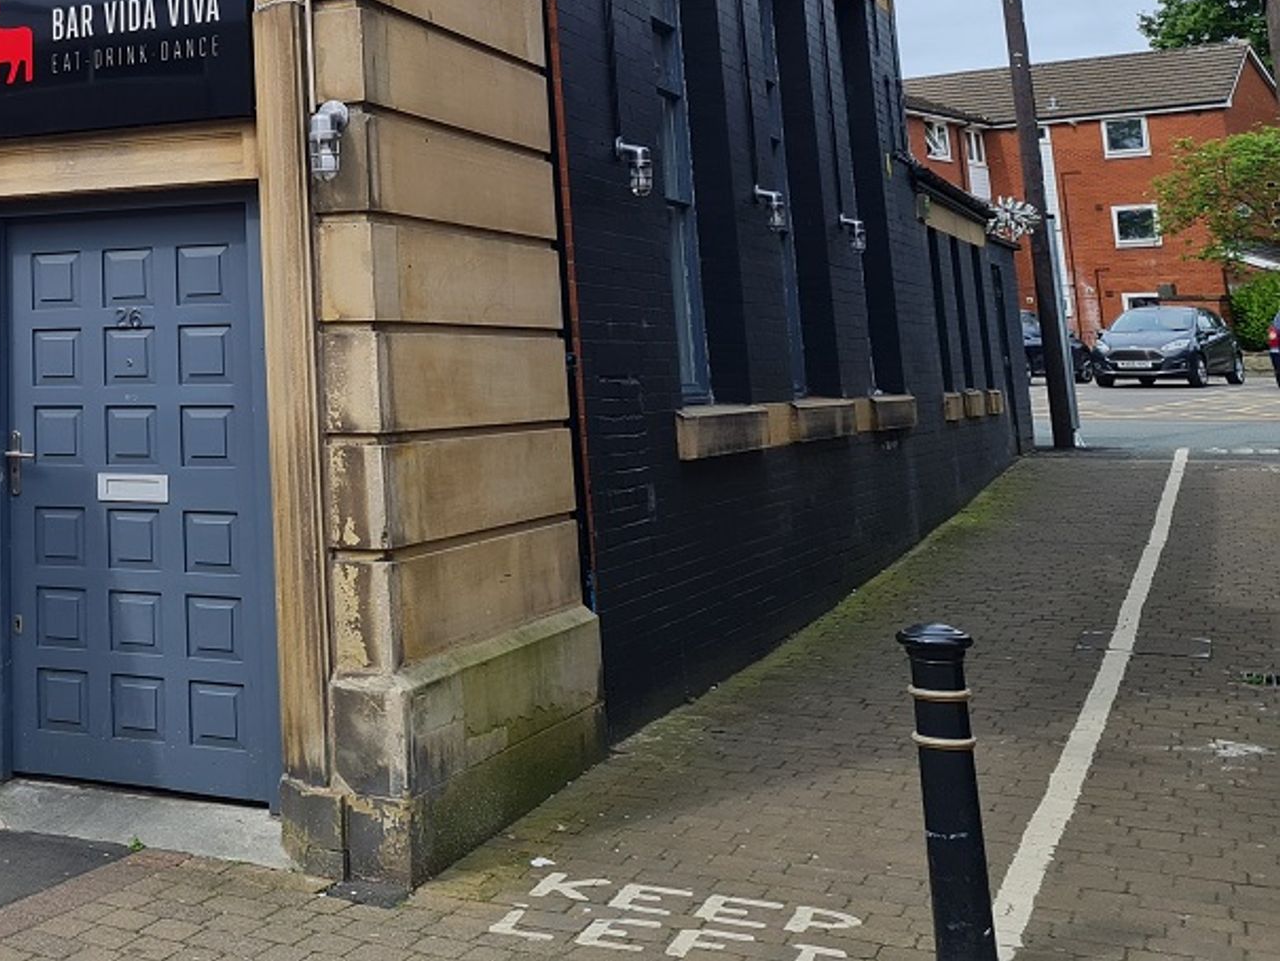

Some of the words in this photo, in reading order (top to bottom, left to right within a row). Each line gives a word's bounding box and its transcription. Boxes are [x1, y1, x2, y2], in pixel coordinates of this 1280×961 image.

[51, 3, 94, 41] BAR
[161, 34, 219, 62] DANCE
[115, 307, 143, 328] 26
[529, 872, 863, 933] KEEP
[488, 903, 848, 961] LEFT
